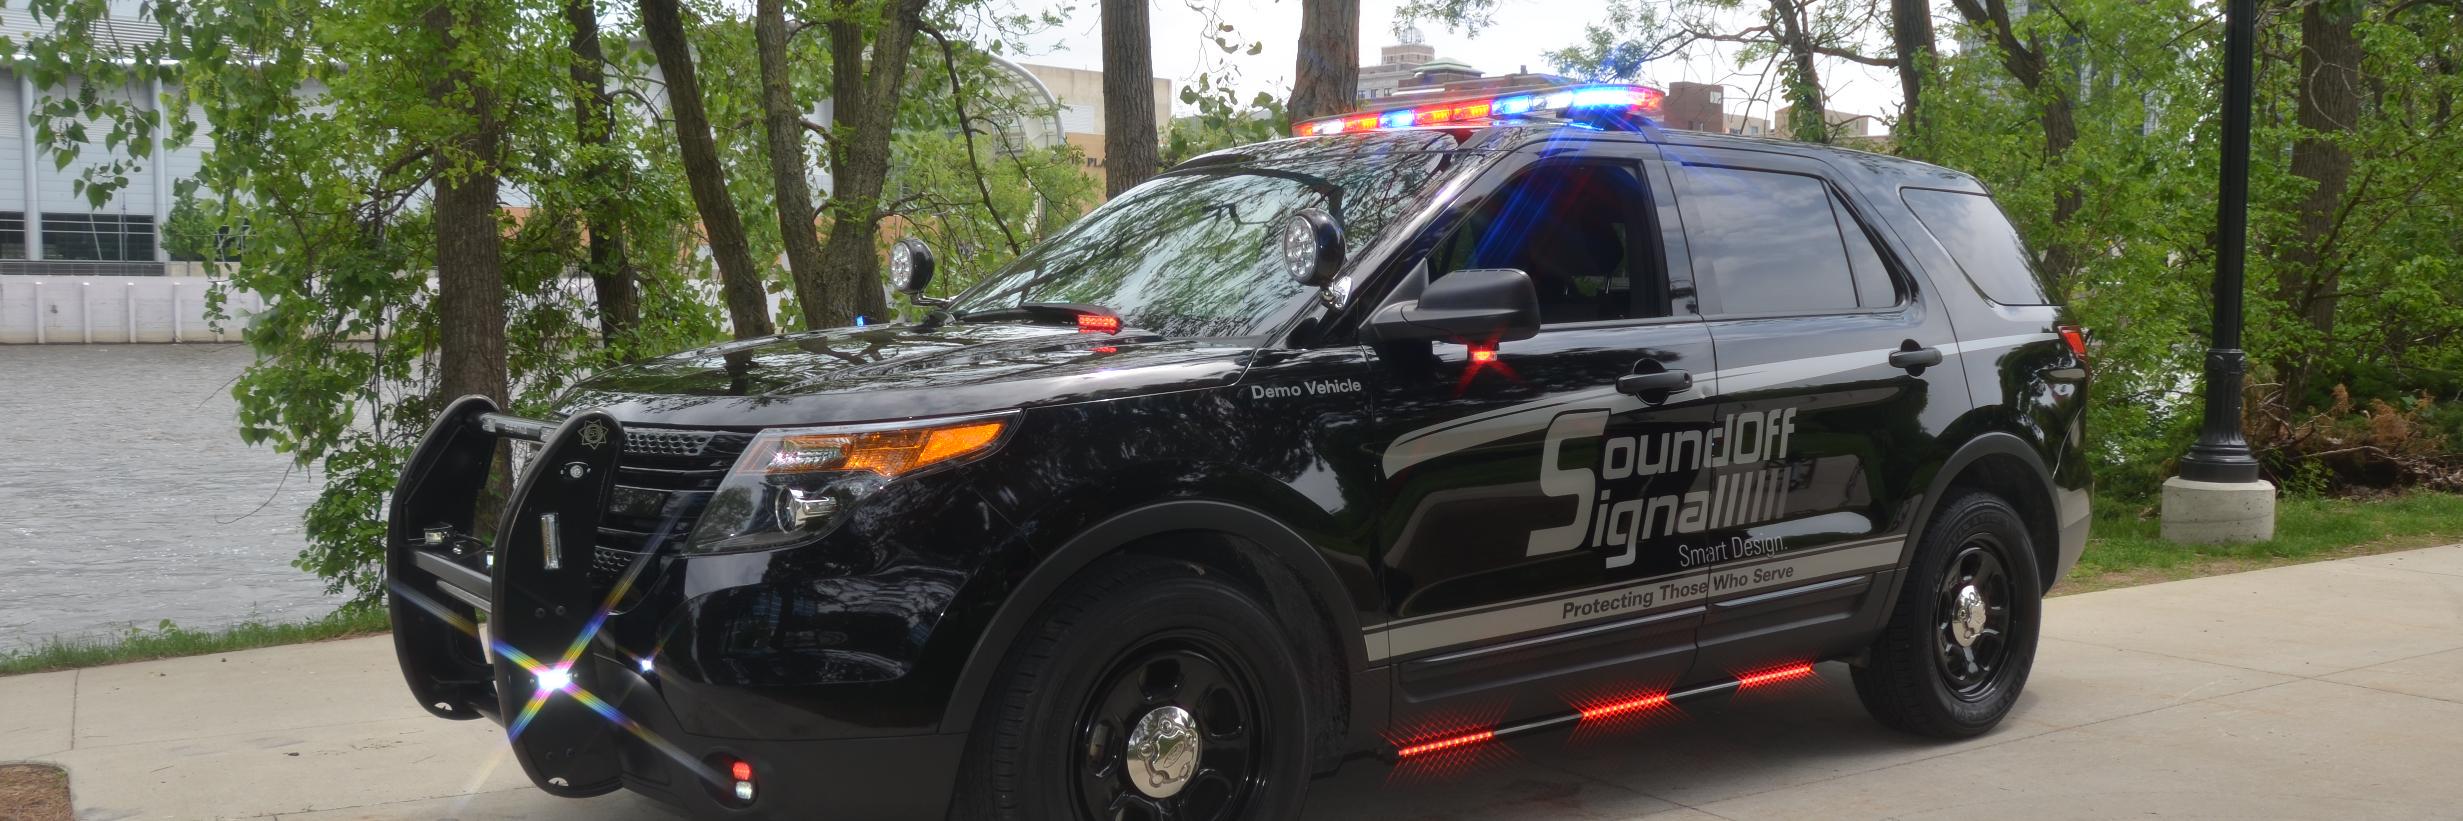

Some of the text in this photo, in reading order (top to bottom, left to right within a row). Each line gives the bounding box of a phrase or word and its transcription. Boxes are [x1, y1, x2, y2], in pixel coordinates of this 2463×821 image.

[1251, 379, 1361, 399] Demo Vehicle
[1679, 535, 1788, 568] Smart Design.
[1562, 566, 1794, 619] Protecting Those Who Serve
